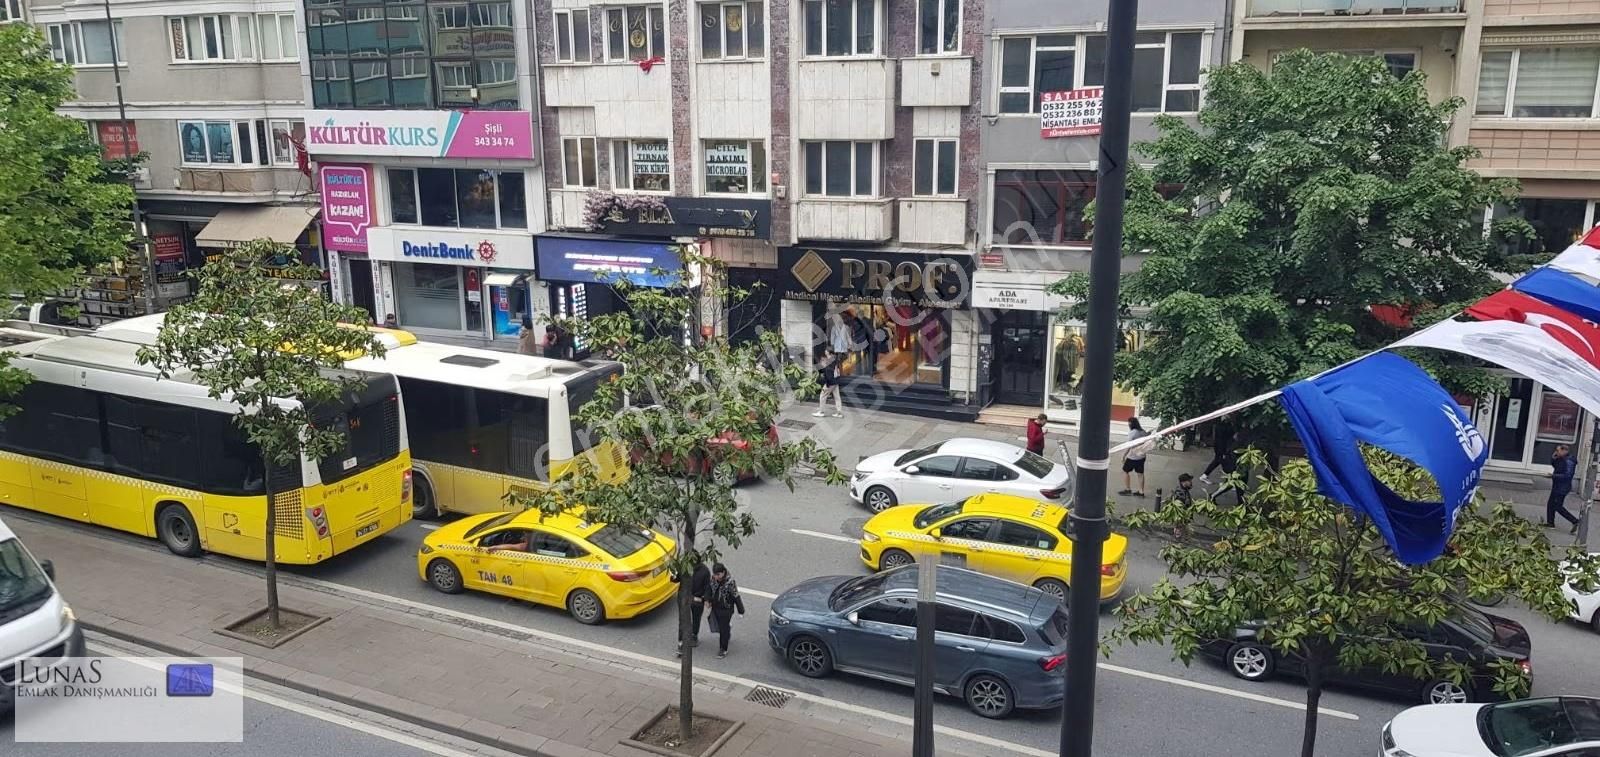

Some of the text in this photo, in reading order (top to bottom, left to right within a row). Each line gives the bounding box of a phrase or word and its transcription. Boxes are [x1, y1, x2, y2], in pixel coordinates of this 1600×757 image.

[1043, 102, 1064, 110] 0532
[1068, 101, 1082, 109] 255
[1043, 111, 1064, 119] 0532
[310, 118, 438, 146] KÜLTÜRKURS
[484, 123, 502, 134] Şişli
[474, 137, 514, 146] 343 34 74
[330, 204, 364, 217] KAZAN!
[403, 240, 475, 261] DenizBank
[478, 570, 513, 586] TAN 48
